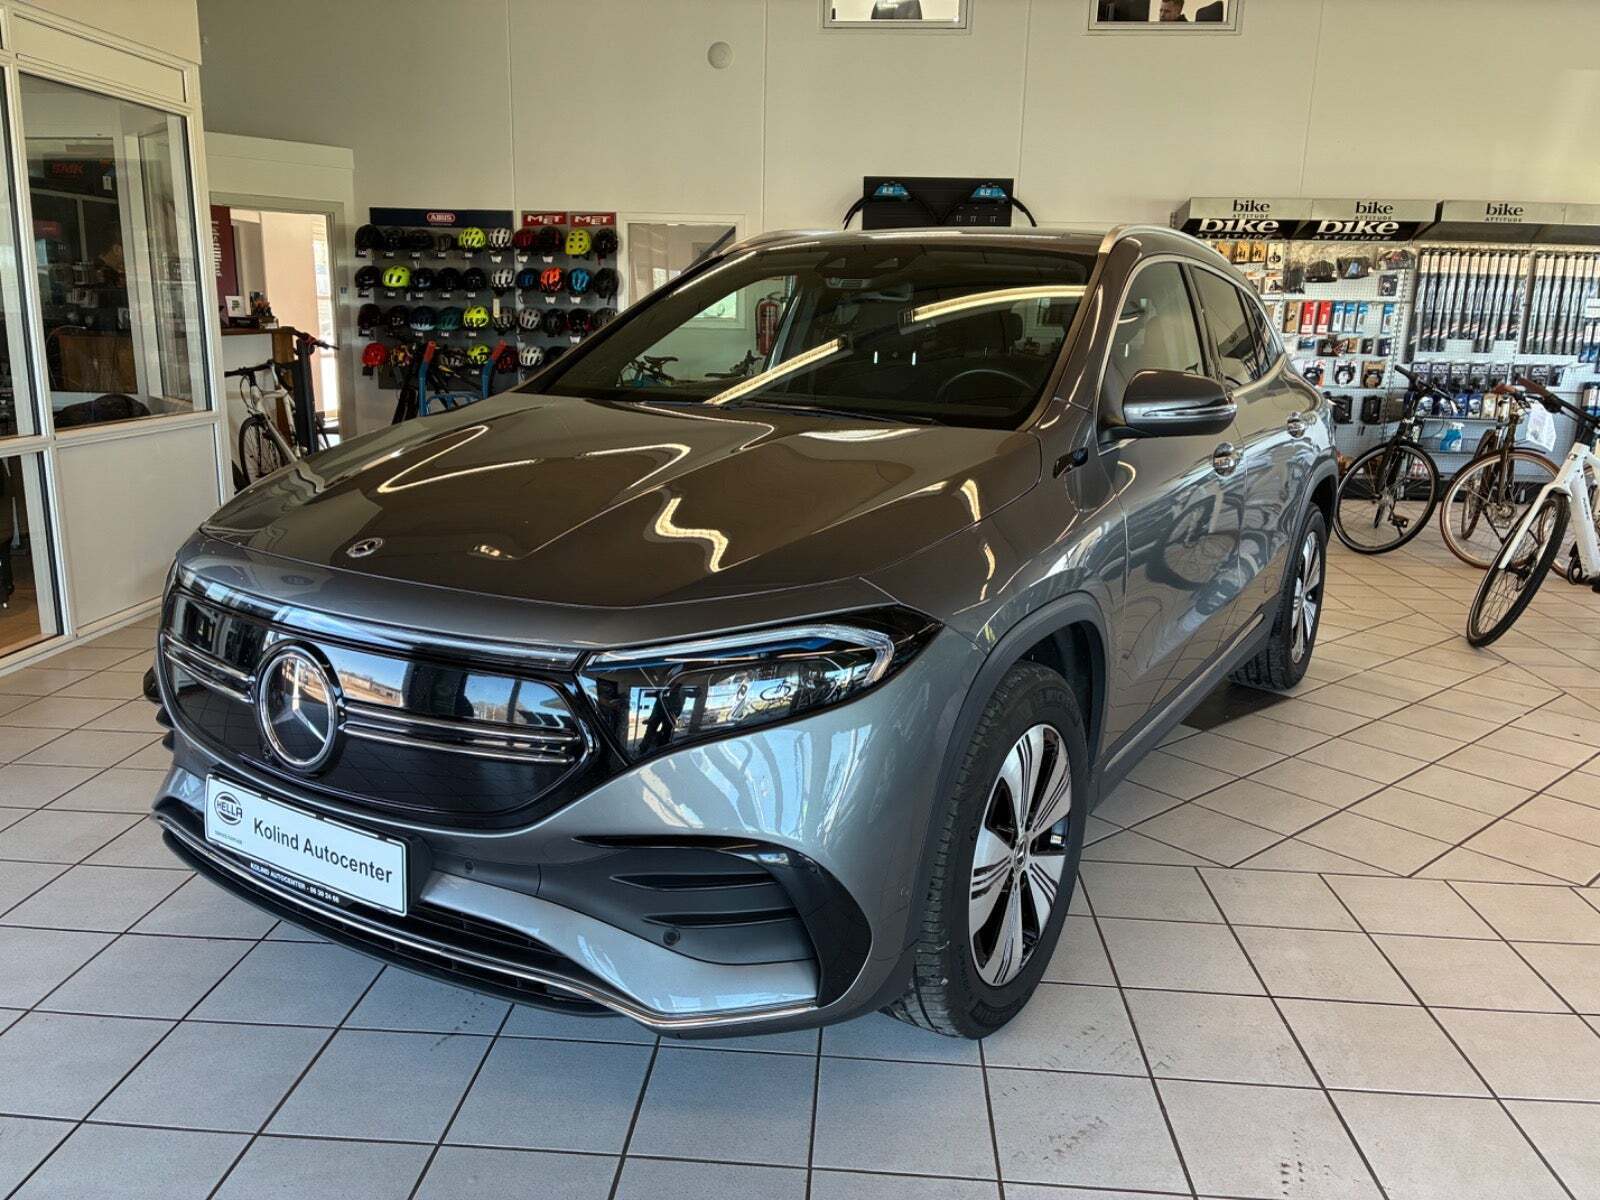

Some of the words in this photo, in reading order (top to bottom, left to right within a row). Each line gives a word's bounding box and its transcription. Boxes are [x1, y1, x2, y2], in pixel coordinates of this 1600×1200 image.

[1232, 199, 1271, 213] bike
[1355, 201, 1393, 214] bike
[1486, 203, 1524, 216] bike
[527, 215, 563, 225] MET
[574, 215, 611, 225] MET
[1199, 218, 1279, 233] bike
[1316, 220, 1400, 234] bike
[216, 799, 243, 818] HELLA
[253, 817, 299, 851] Kolind
[303, 837, 393, 883] Autocenter
